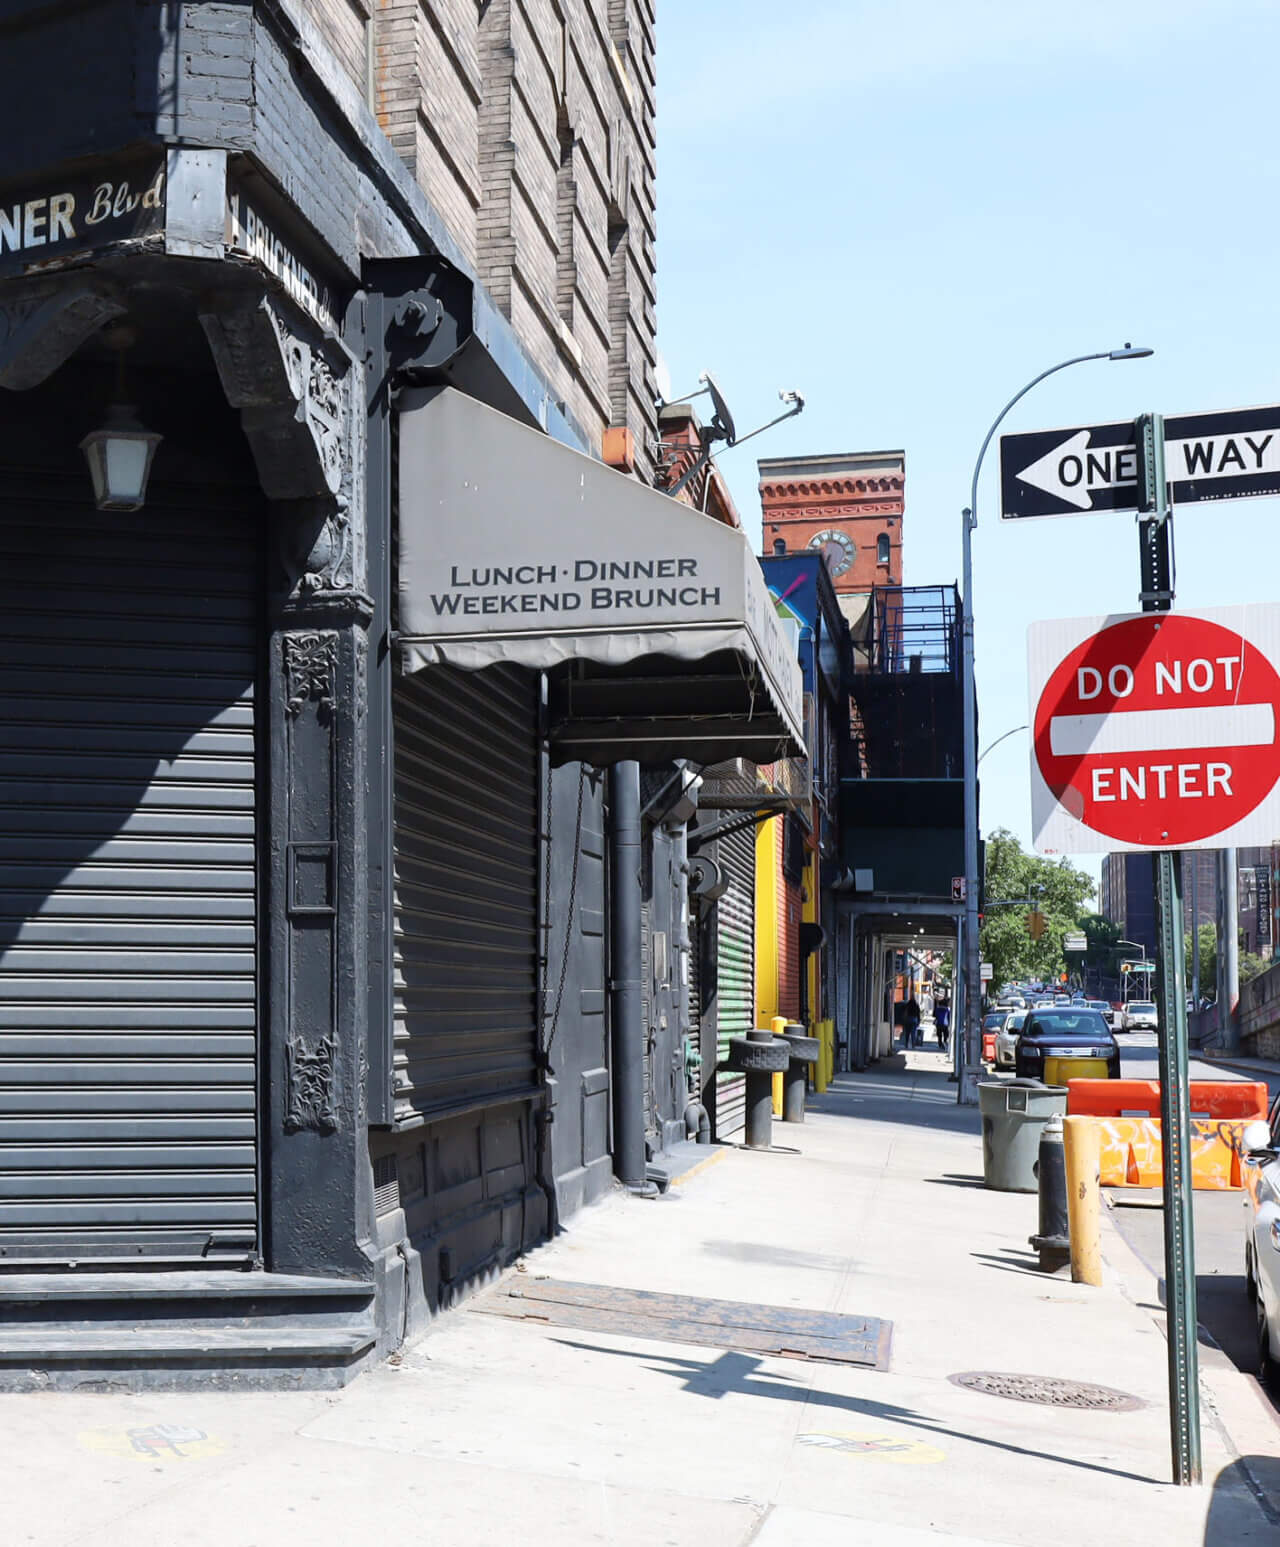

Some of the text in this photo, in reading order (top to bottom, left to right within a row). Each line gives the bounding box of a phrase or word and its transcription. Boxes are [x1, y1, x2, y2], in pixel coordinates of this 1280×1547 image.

[1058, 434, 1274, 487] ONE WAY
[450, 558, 698, 587] LUNCH DINNER
[430, 586, 721, 616] WEEKEND BRUNCH
[1077, 656, 1241, 700] DO NOT
[1091, 762, 1233, 802] ENTER
